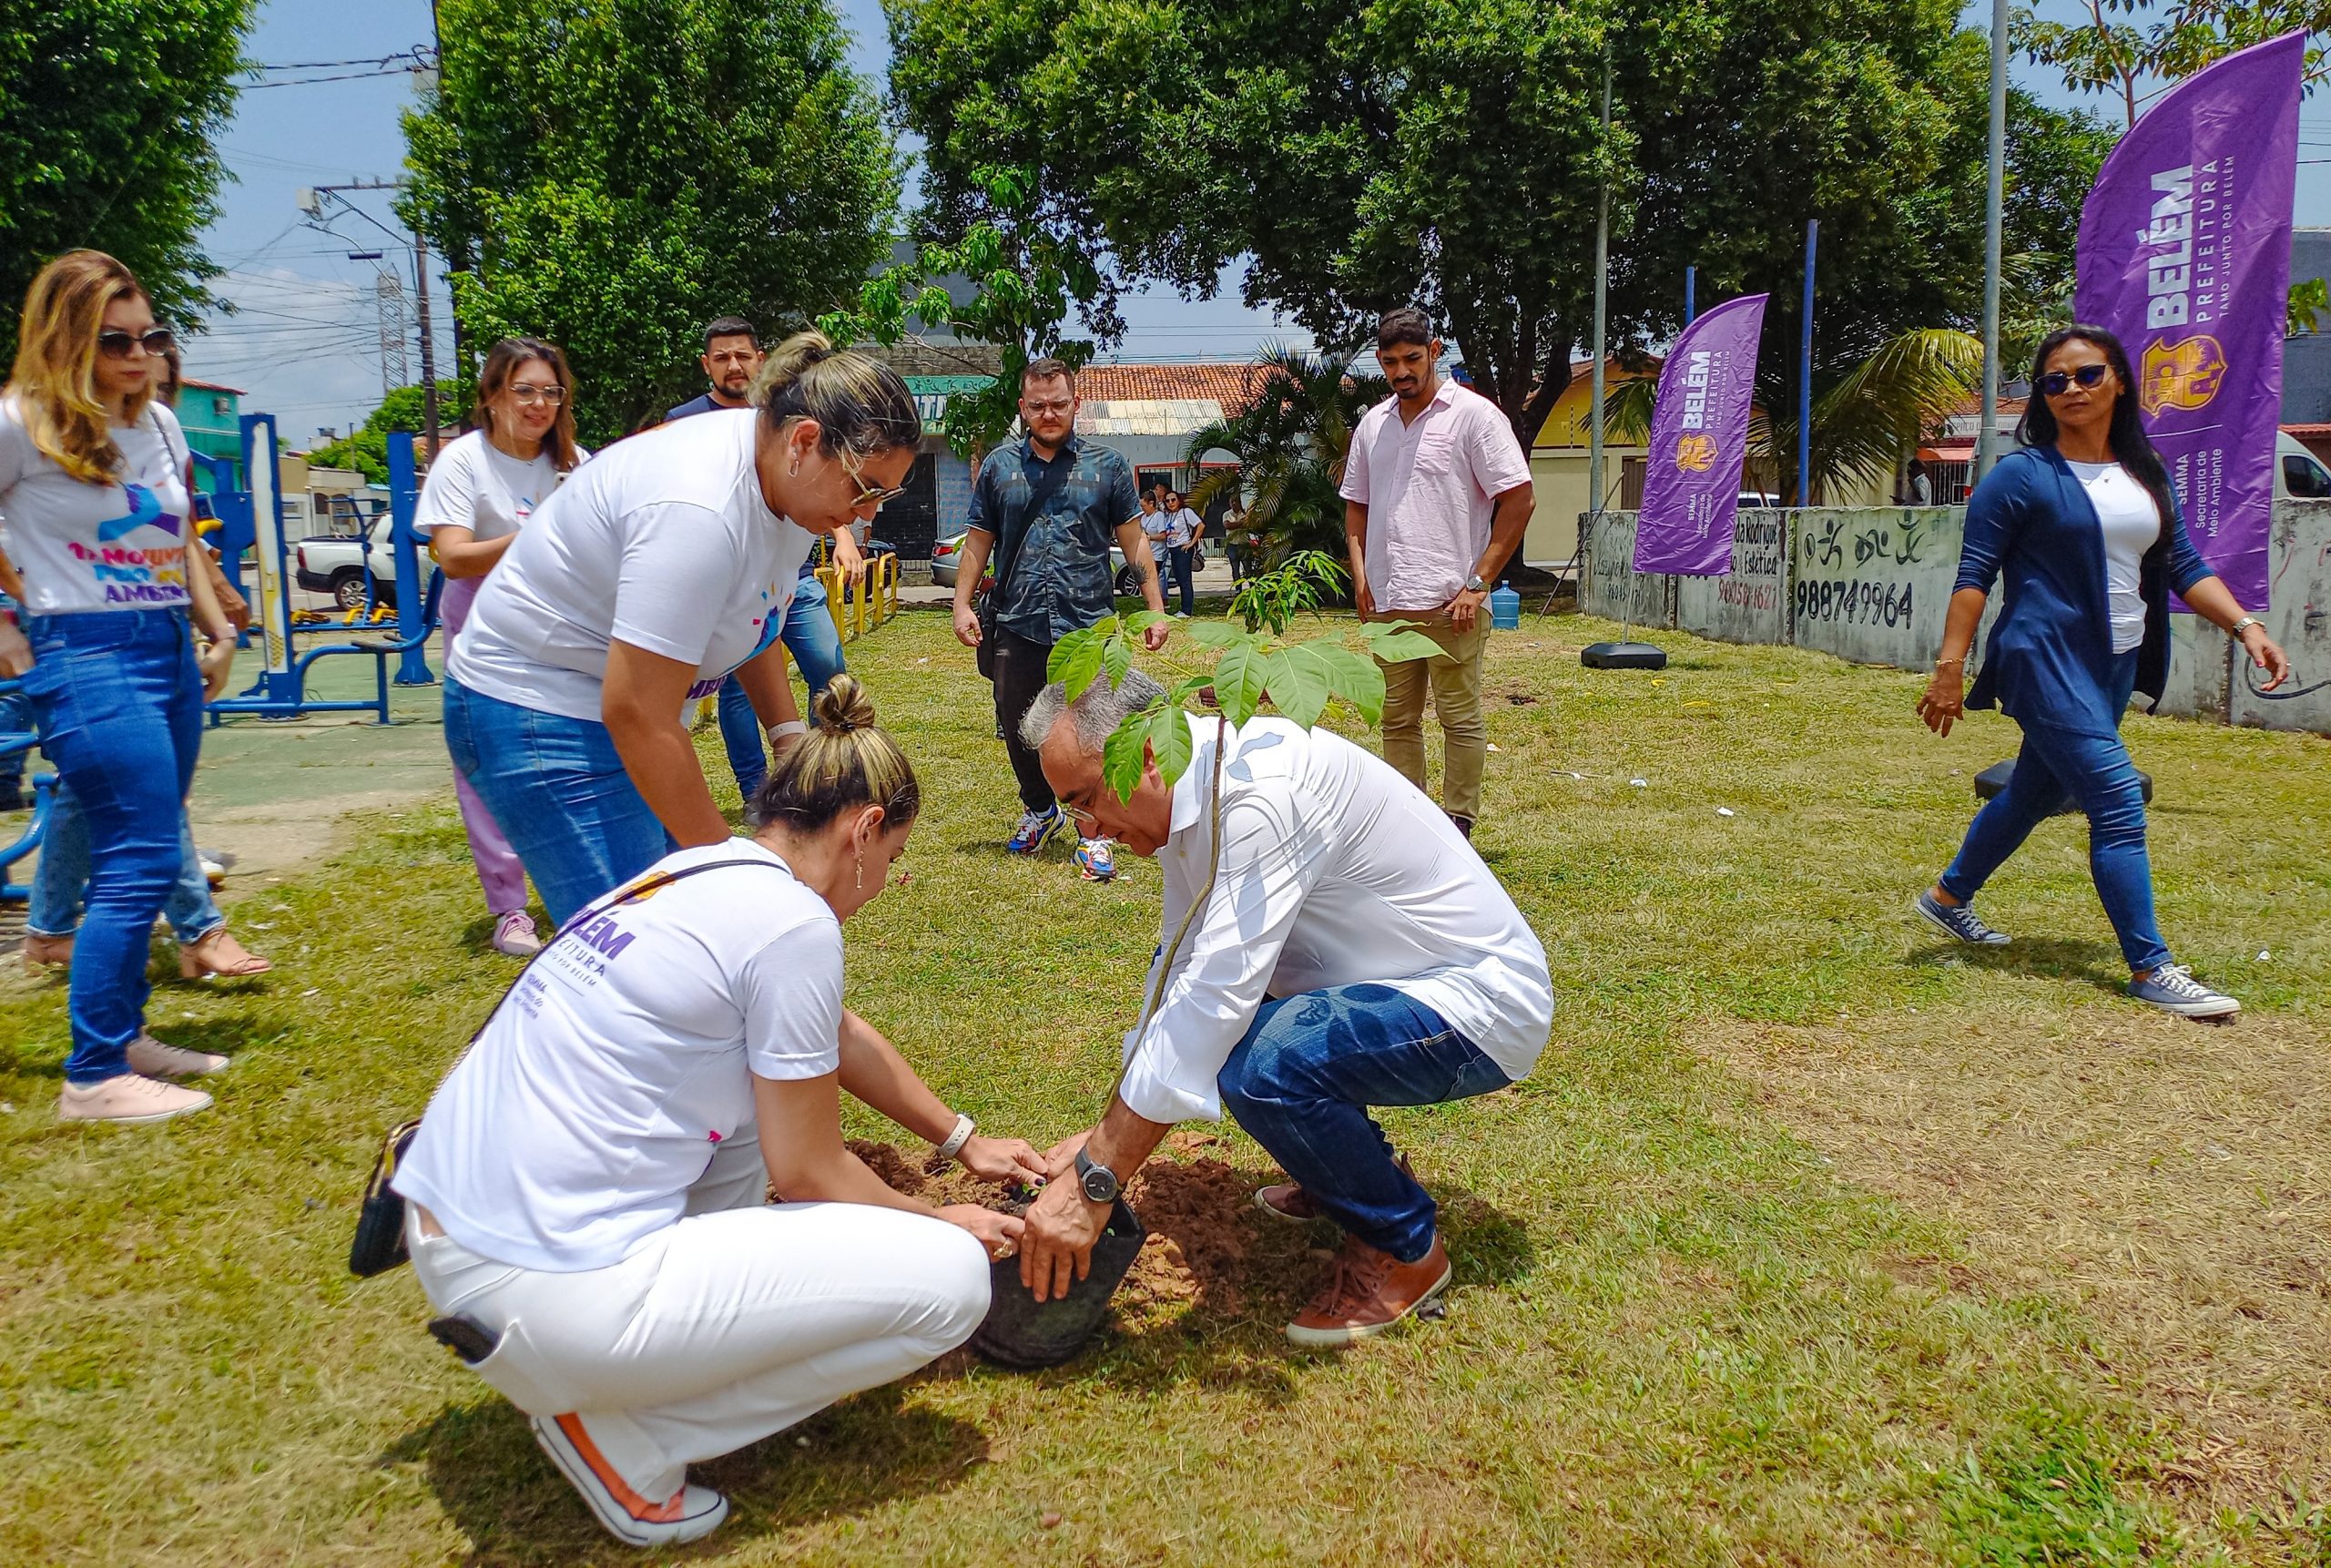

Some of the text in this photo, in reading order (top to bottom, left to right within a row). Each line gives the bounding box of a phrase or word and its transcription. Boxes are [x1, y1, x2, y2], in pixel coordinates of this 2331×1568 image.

[2135, 165, 2194, 330] BELÉM
[2196, 159, 2218, 322] PREFEITURA
[2219, 156, 2234, 319] TAMO JUNTO POR BELÉM
[1681, 351, 1711, 429] BELÉM
[1705, 351, 1723, 430] PREFEITURA
[1687, 493, 1697, 521] SEMMA
[2175, 453, 2189, 505] SEMMA
[2194, 450, 2207, 528] Secretaria de
[2207, 448, 2222, 537] Meio Ambiente
[1797, 578, 1913, 630] 988749964
